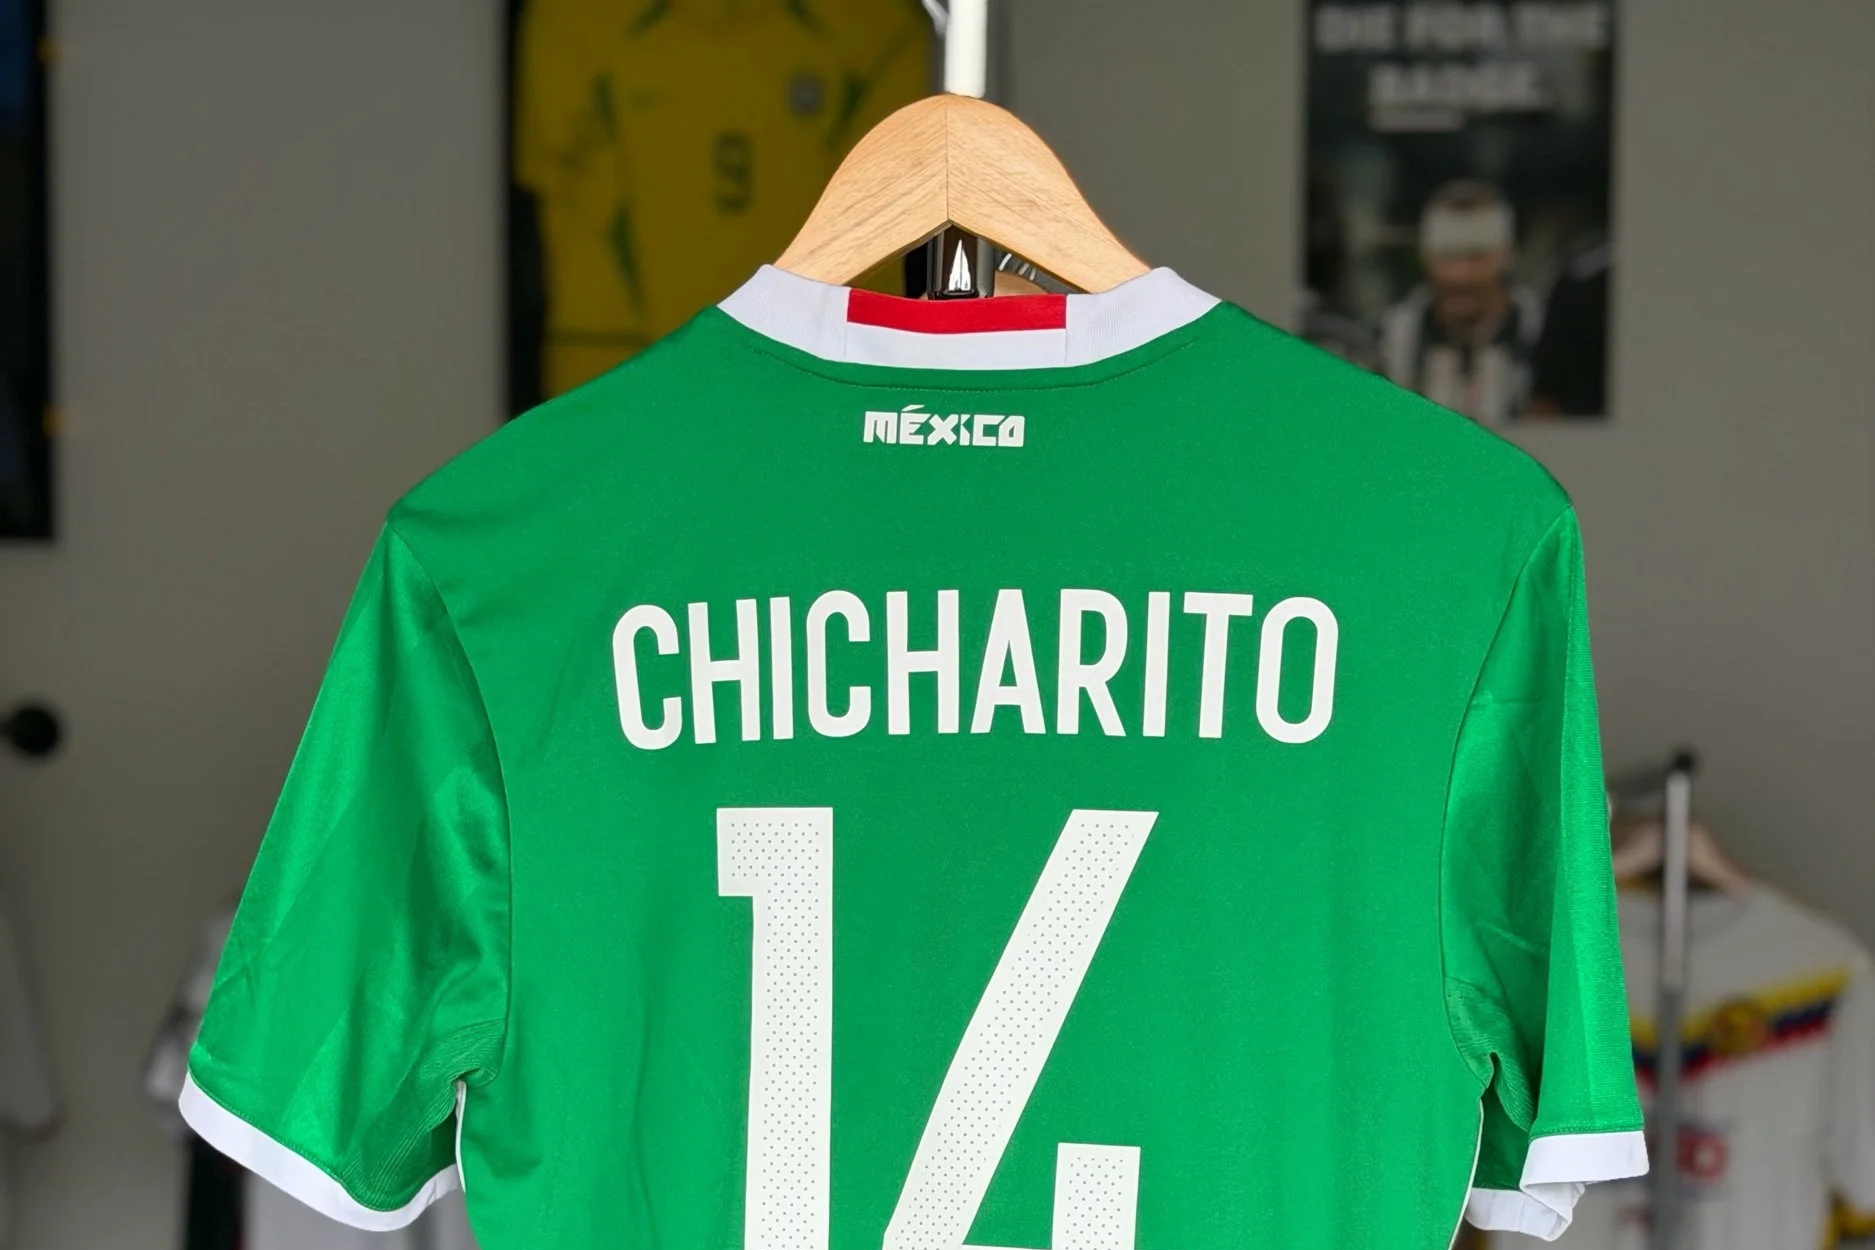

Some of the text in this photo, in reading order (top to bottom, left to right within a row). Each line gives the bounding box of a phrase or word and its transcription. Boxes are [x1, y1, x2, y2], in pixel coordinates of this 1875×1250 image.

[1314, 2, 1605, 52] DIE FOR THE
[712, 131, 754, 214] 9
[863, 404, 1026, 448] MÉXICO
[612, 588, 1339, 750] CHICHARITO
